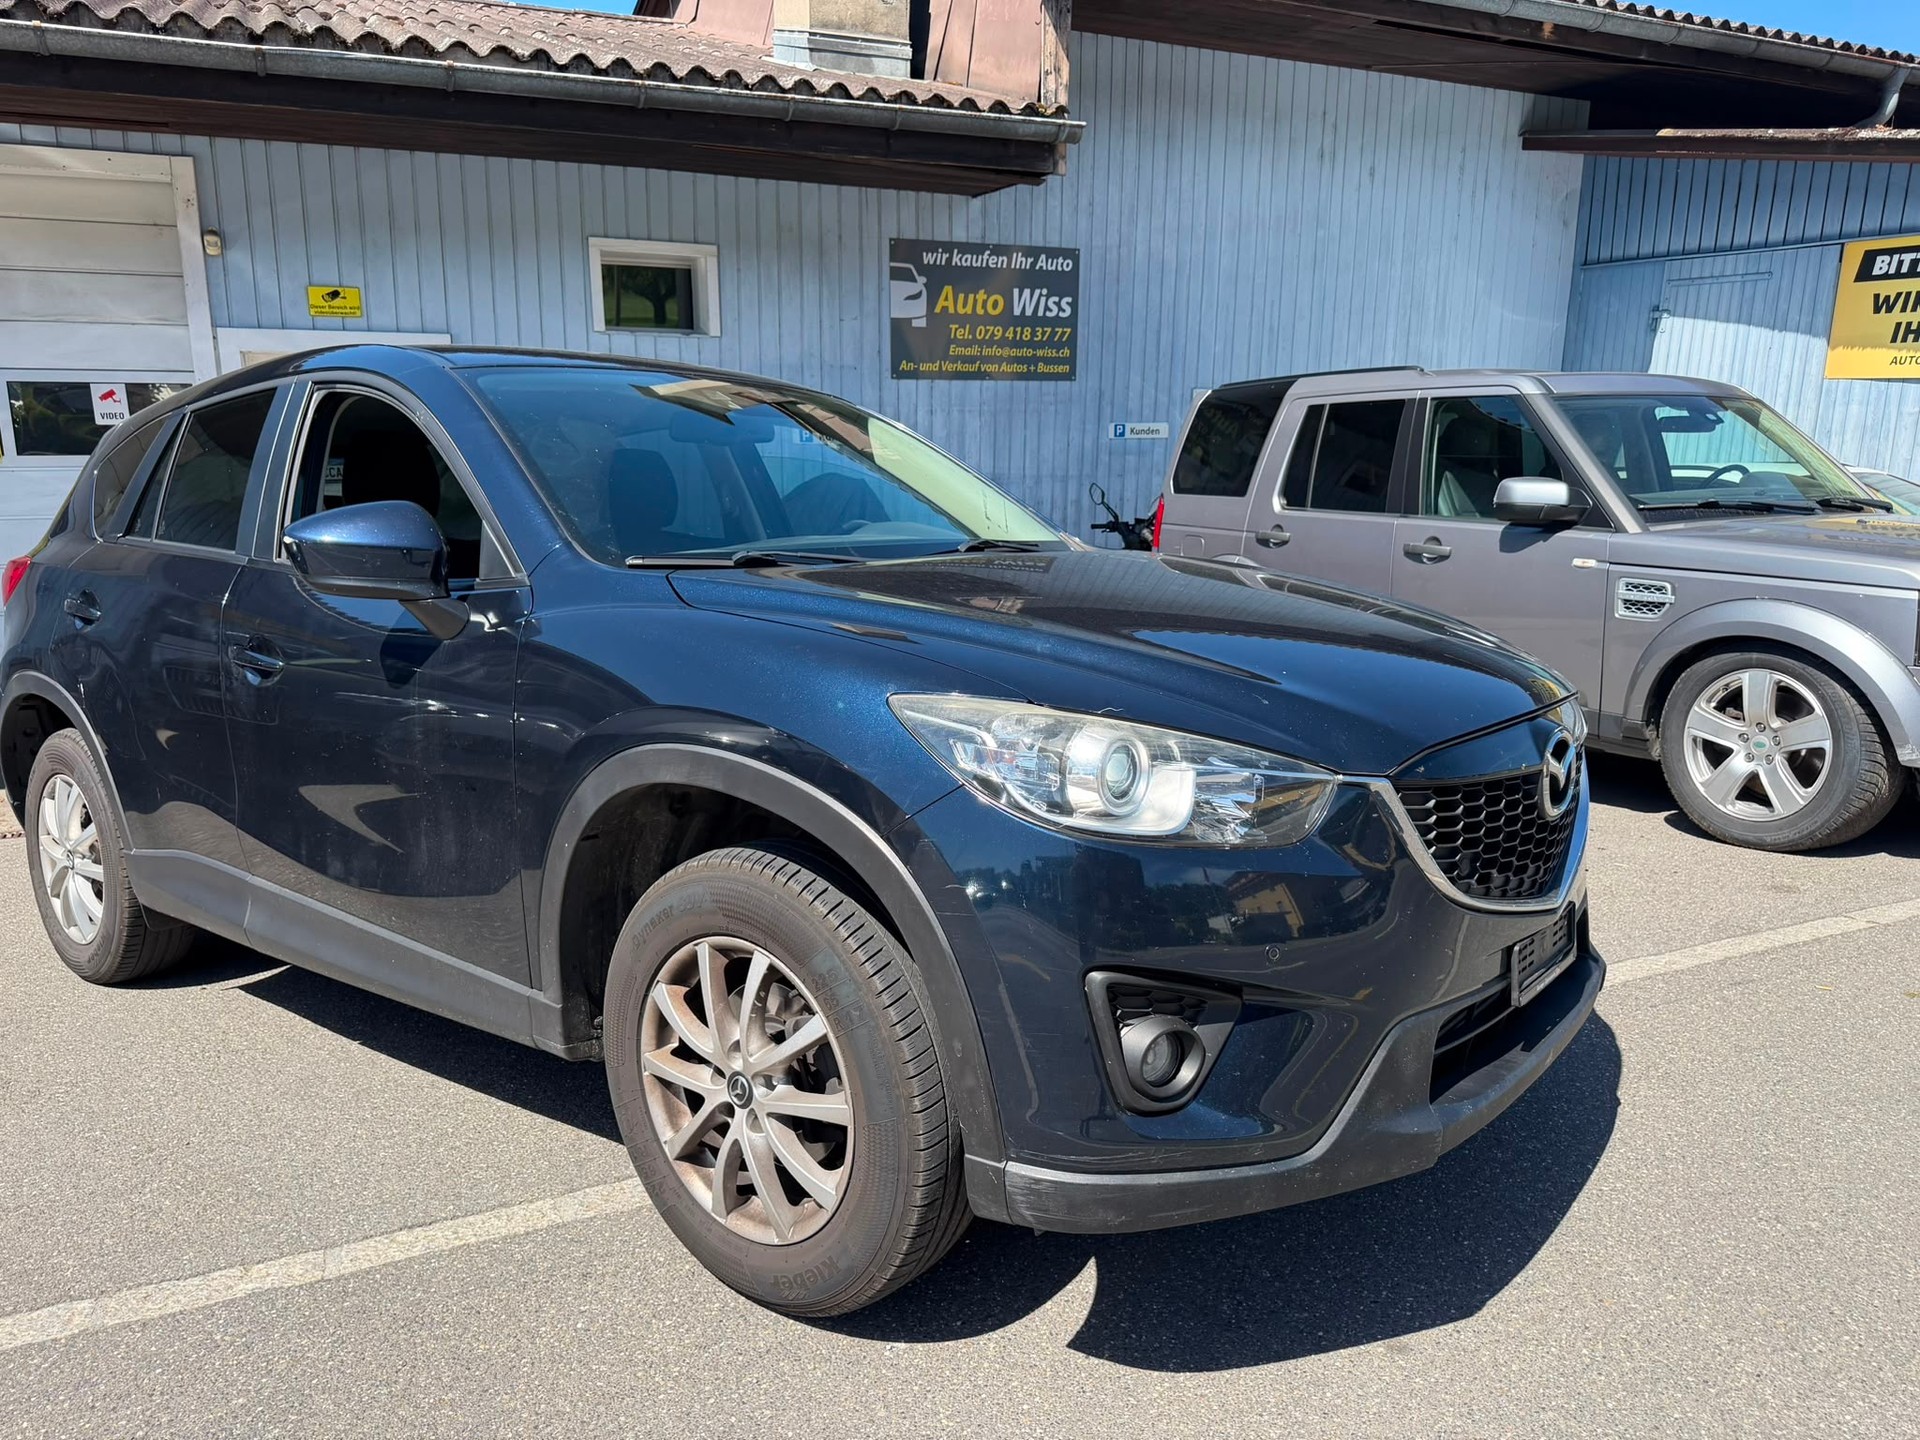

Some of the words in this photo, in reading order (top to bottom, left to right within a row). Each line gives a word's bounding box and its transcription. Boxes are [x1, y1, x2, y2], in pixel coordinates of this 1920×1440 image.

[923, 249, 949, 266] wir
[952, 249, 1008, 269] kaufen
[1011, 252, 1033, 270] Ihr
[1035, 253, 1073, 272] Auto
[1872, 252, 1920, 275] BIT
[934, 285, 1005, 316] Auto
[1013, 287, 1072, 318] Wiss
[949, 324, 972, 340] Tel.
[976, 325, 1002, 340] 079
[1005, 326, 1031, 341] 418
[1034, 327, 1050, 342] 37
[1054, 327, 1071, 342] 77
[949, 345, 980, 356] Email:
[982, 345, 1070, 358] info@auto-wiss.ch
[899, 360, 918, 371] An-
[919, 361, 939, 371] und
[941, 360, 980, 372] Verkauf
[980, 364, 998, 373] von
[1000, 361, 1027, 373] Autos
[1037, 362, 1070, 374] Bussen
[100, 412, 125, 420] VIDEO
[1130, 427, 1160, 435] Kunden
